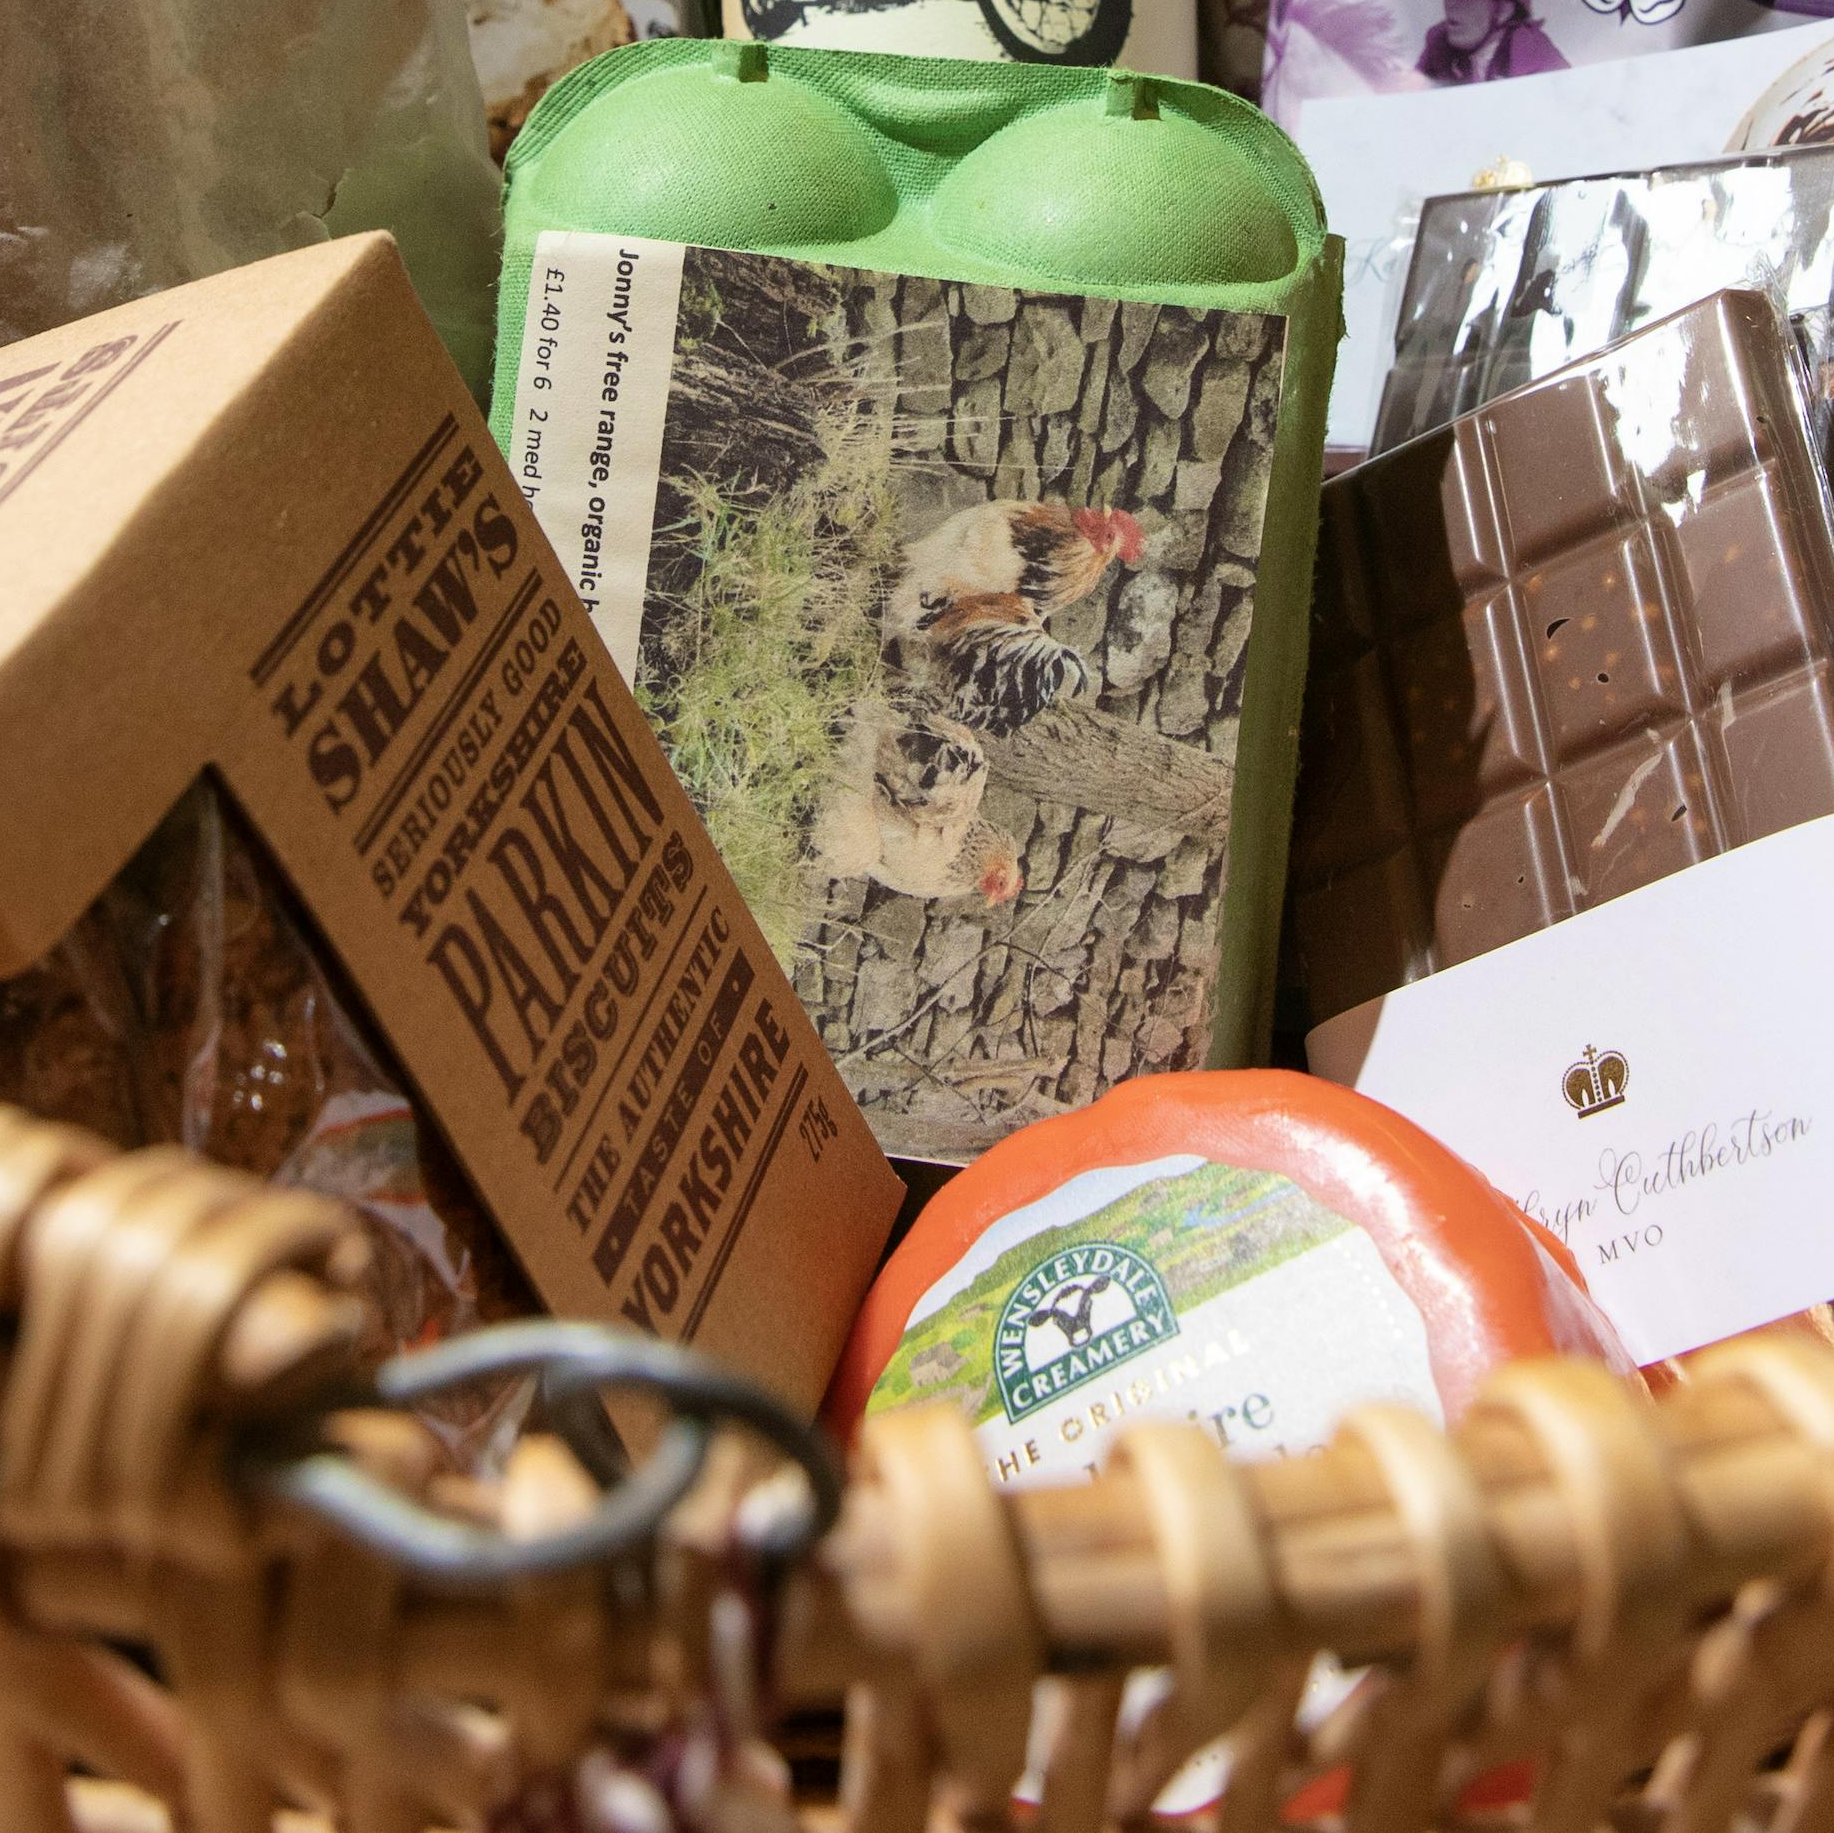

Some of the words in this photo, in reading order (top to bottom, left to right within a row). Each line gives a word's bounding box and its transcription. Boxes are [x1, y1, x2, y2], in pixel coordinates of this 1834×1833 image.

[540, 266, 565, 333] £1.40
[607, 247, 640, 347] Jonny's
[533, 377, 552, 391] 6
[535, 337, 559, 375] for
[601, 351, 630, 404] free
[523, 429, 543, 479] med
[529, 408, 549, 422] 2
[588, 410, 616, 489] range,
[271, 444, 484, 739] LOTTIE
[581, 496, 607, 591] organic
[306, 492, 519, 816] SHAW'S
[371, 689, 507, 900] SERIOUSLY
[500, 597, 561, 697] GOOD
[398, 637, 589, 939] YORKSHIRE
[426, 675, 665, 1108] PARKIN
[519, 830, 695, 1167] BISCUITS
[566, 1134, 622, 1236] THE
[616, 905, 730, 1144] AUTHENTIC
[625, 1079, 699, 1218] TASTE
[698, 1015, 725, 1067] OF
[619, 997, 792, 1340] YORKSHIRE
[798, 1094, 839, 1164] 275g
[1594, 1108, 1813, 1216] Cuthbertson
[1597, 1223, 1665, 1266] MVO
[1001, 1248, 1158, 1380] WENSLEYDALE
[1011, 1309, 1169, 1411] CREAMERY
[995, 1439, 1041, 1484] HE
[1060, 1328, 1252, 1444] ORIGINAL
